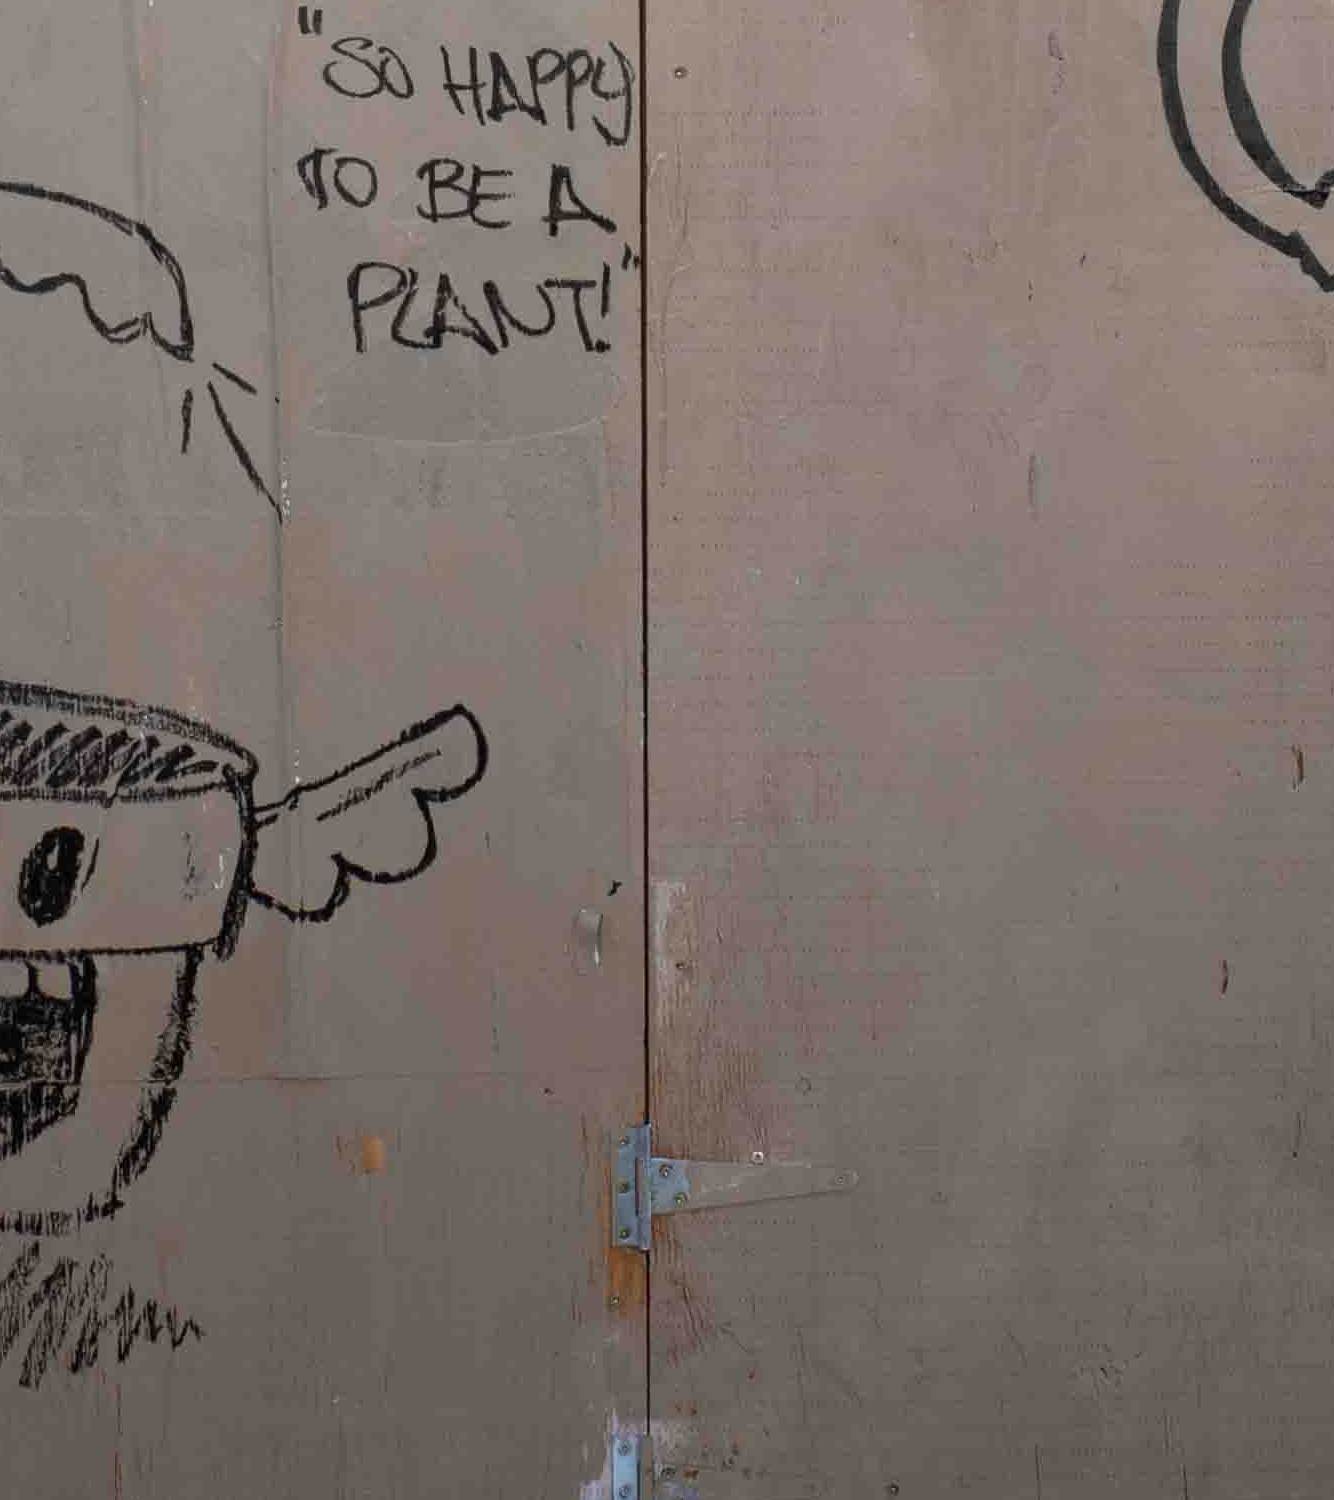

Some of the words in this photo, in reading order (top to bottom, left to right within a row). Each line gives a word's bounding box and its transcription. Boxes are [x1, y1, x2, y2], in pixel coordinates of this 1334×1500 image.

[296, 148, 379, 210] TO
[416, 157, 514, 230] BE
[542, 163, 618, 238] A
